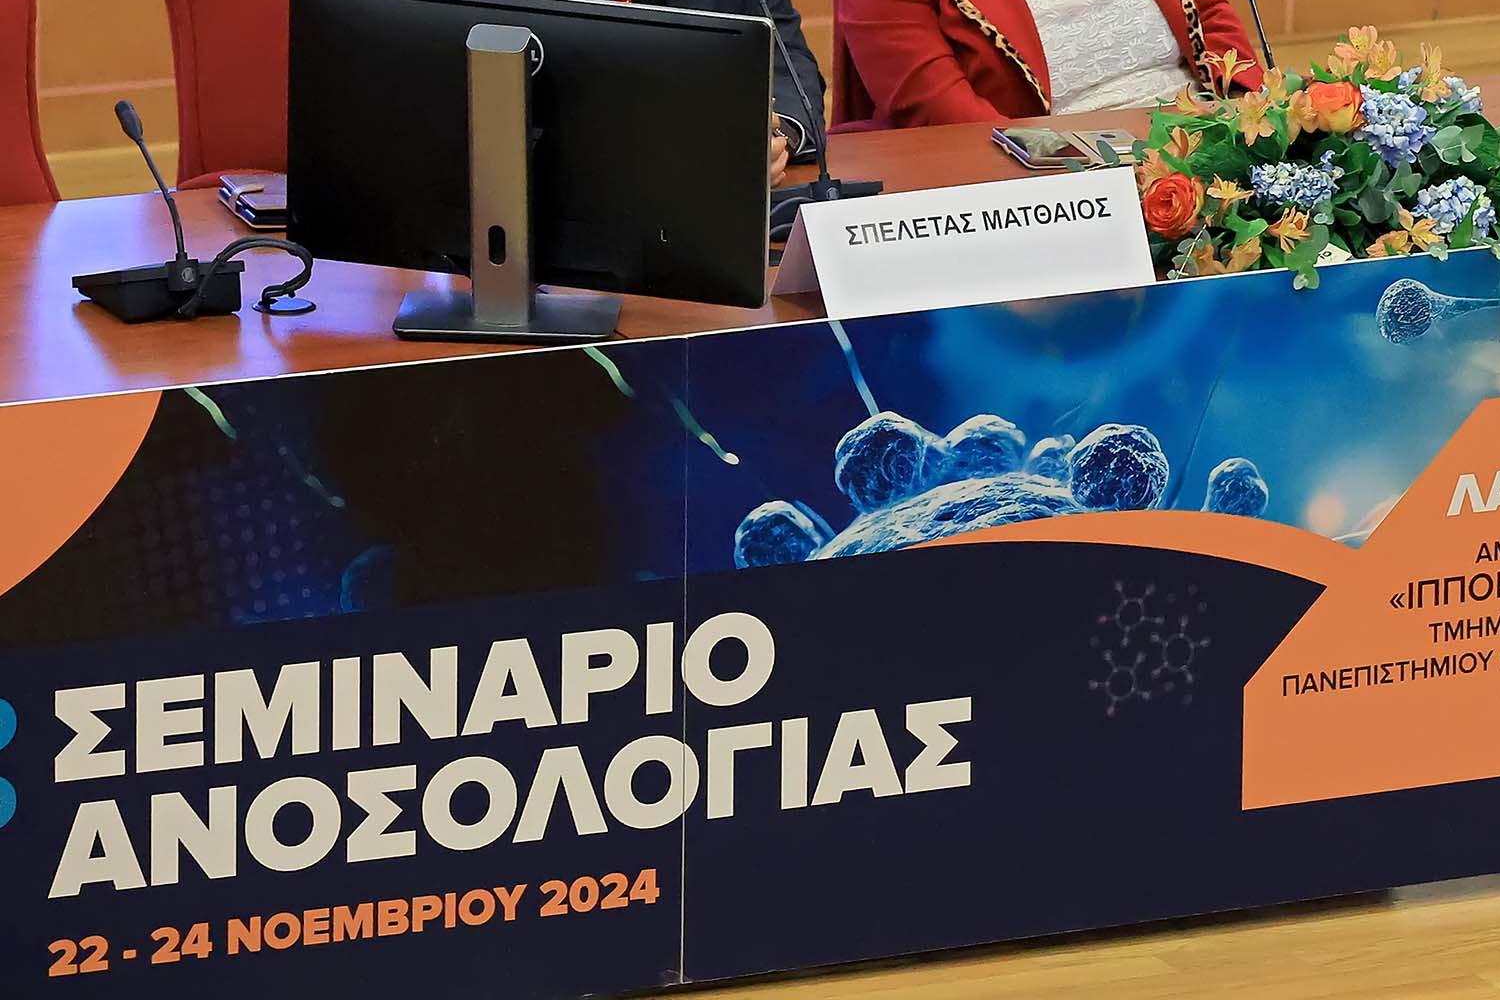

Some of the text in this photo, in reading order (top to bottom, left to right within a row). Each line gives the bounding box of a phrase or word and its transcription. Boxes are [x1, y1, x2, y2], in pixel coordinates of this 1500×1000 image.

[845, 197, 1112, 247] ΣΠΕΛΕΤΑΣ ΜΑΤΘΑΙΟΣ
[54, 611, 776, 784] ΣΕΜΙΝΑΡΙΟ
[1282, 650, 1494, 697] ΠΑΝΕΠΙΣΤΗΜΙΟΥ
[48, 696, 972, 899] ΑΝΟΣΟΛΟΓΙΑΣ
[48, 935, 109, 978] 22
[150, 925, 212, 965] 24
[227, 883, 528, 956] ΝΟΕΜΒΡΙΟΥ
[539, 869, 661, 917] 2024
